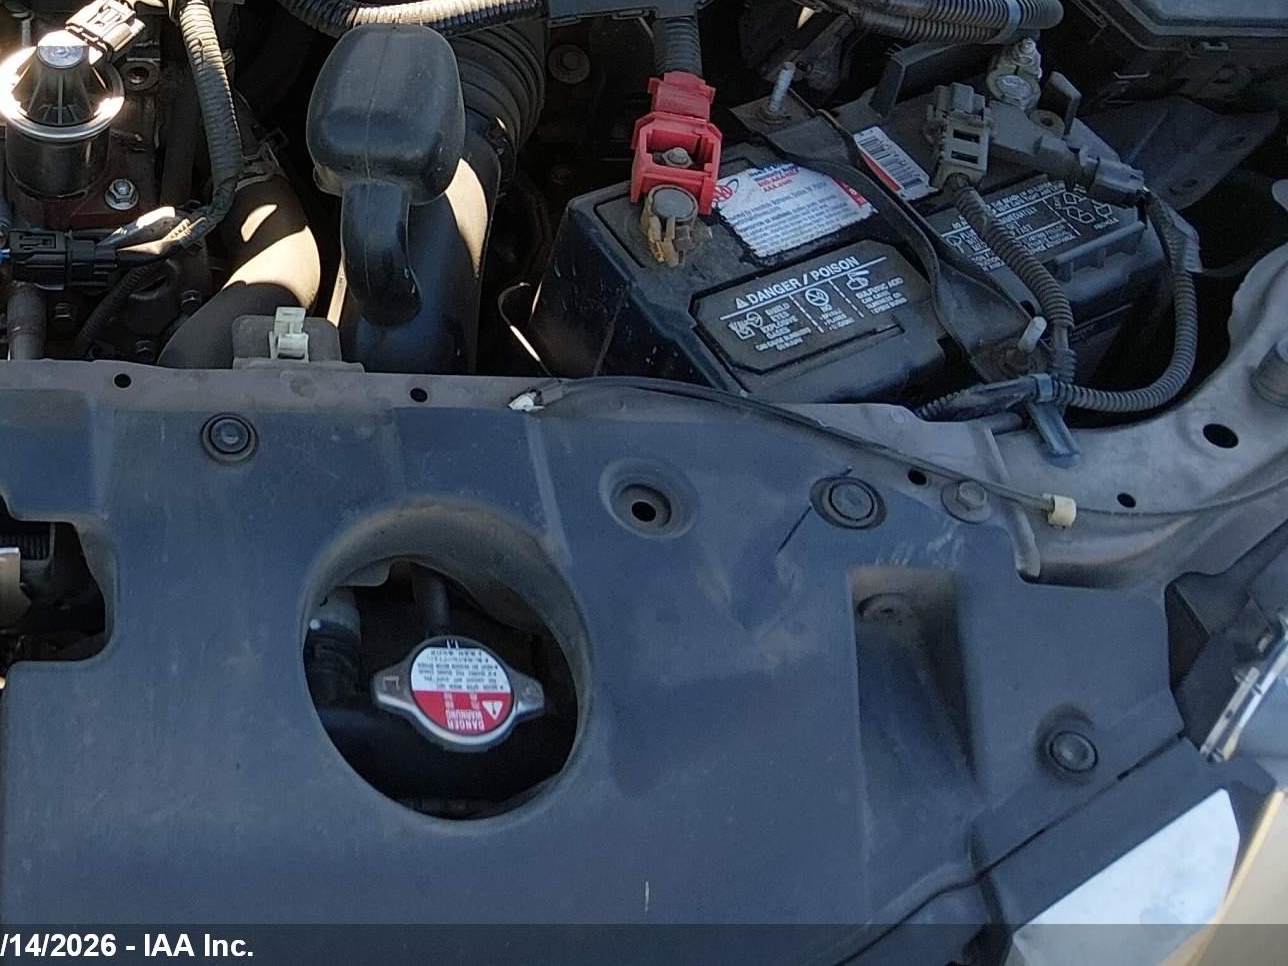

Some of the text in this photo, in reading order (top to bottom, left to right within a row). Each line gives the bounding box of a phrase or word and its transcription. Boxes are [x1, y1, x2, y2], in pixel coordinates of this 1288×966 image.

[745, 278, 803, 305] DANGER
[809, 256, 860, 281] POISON
[447, 719, 485, 731] DANGER
